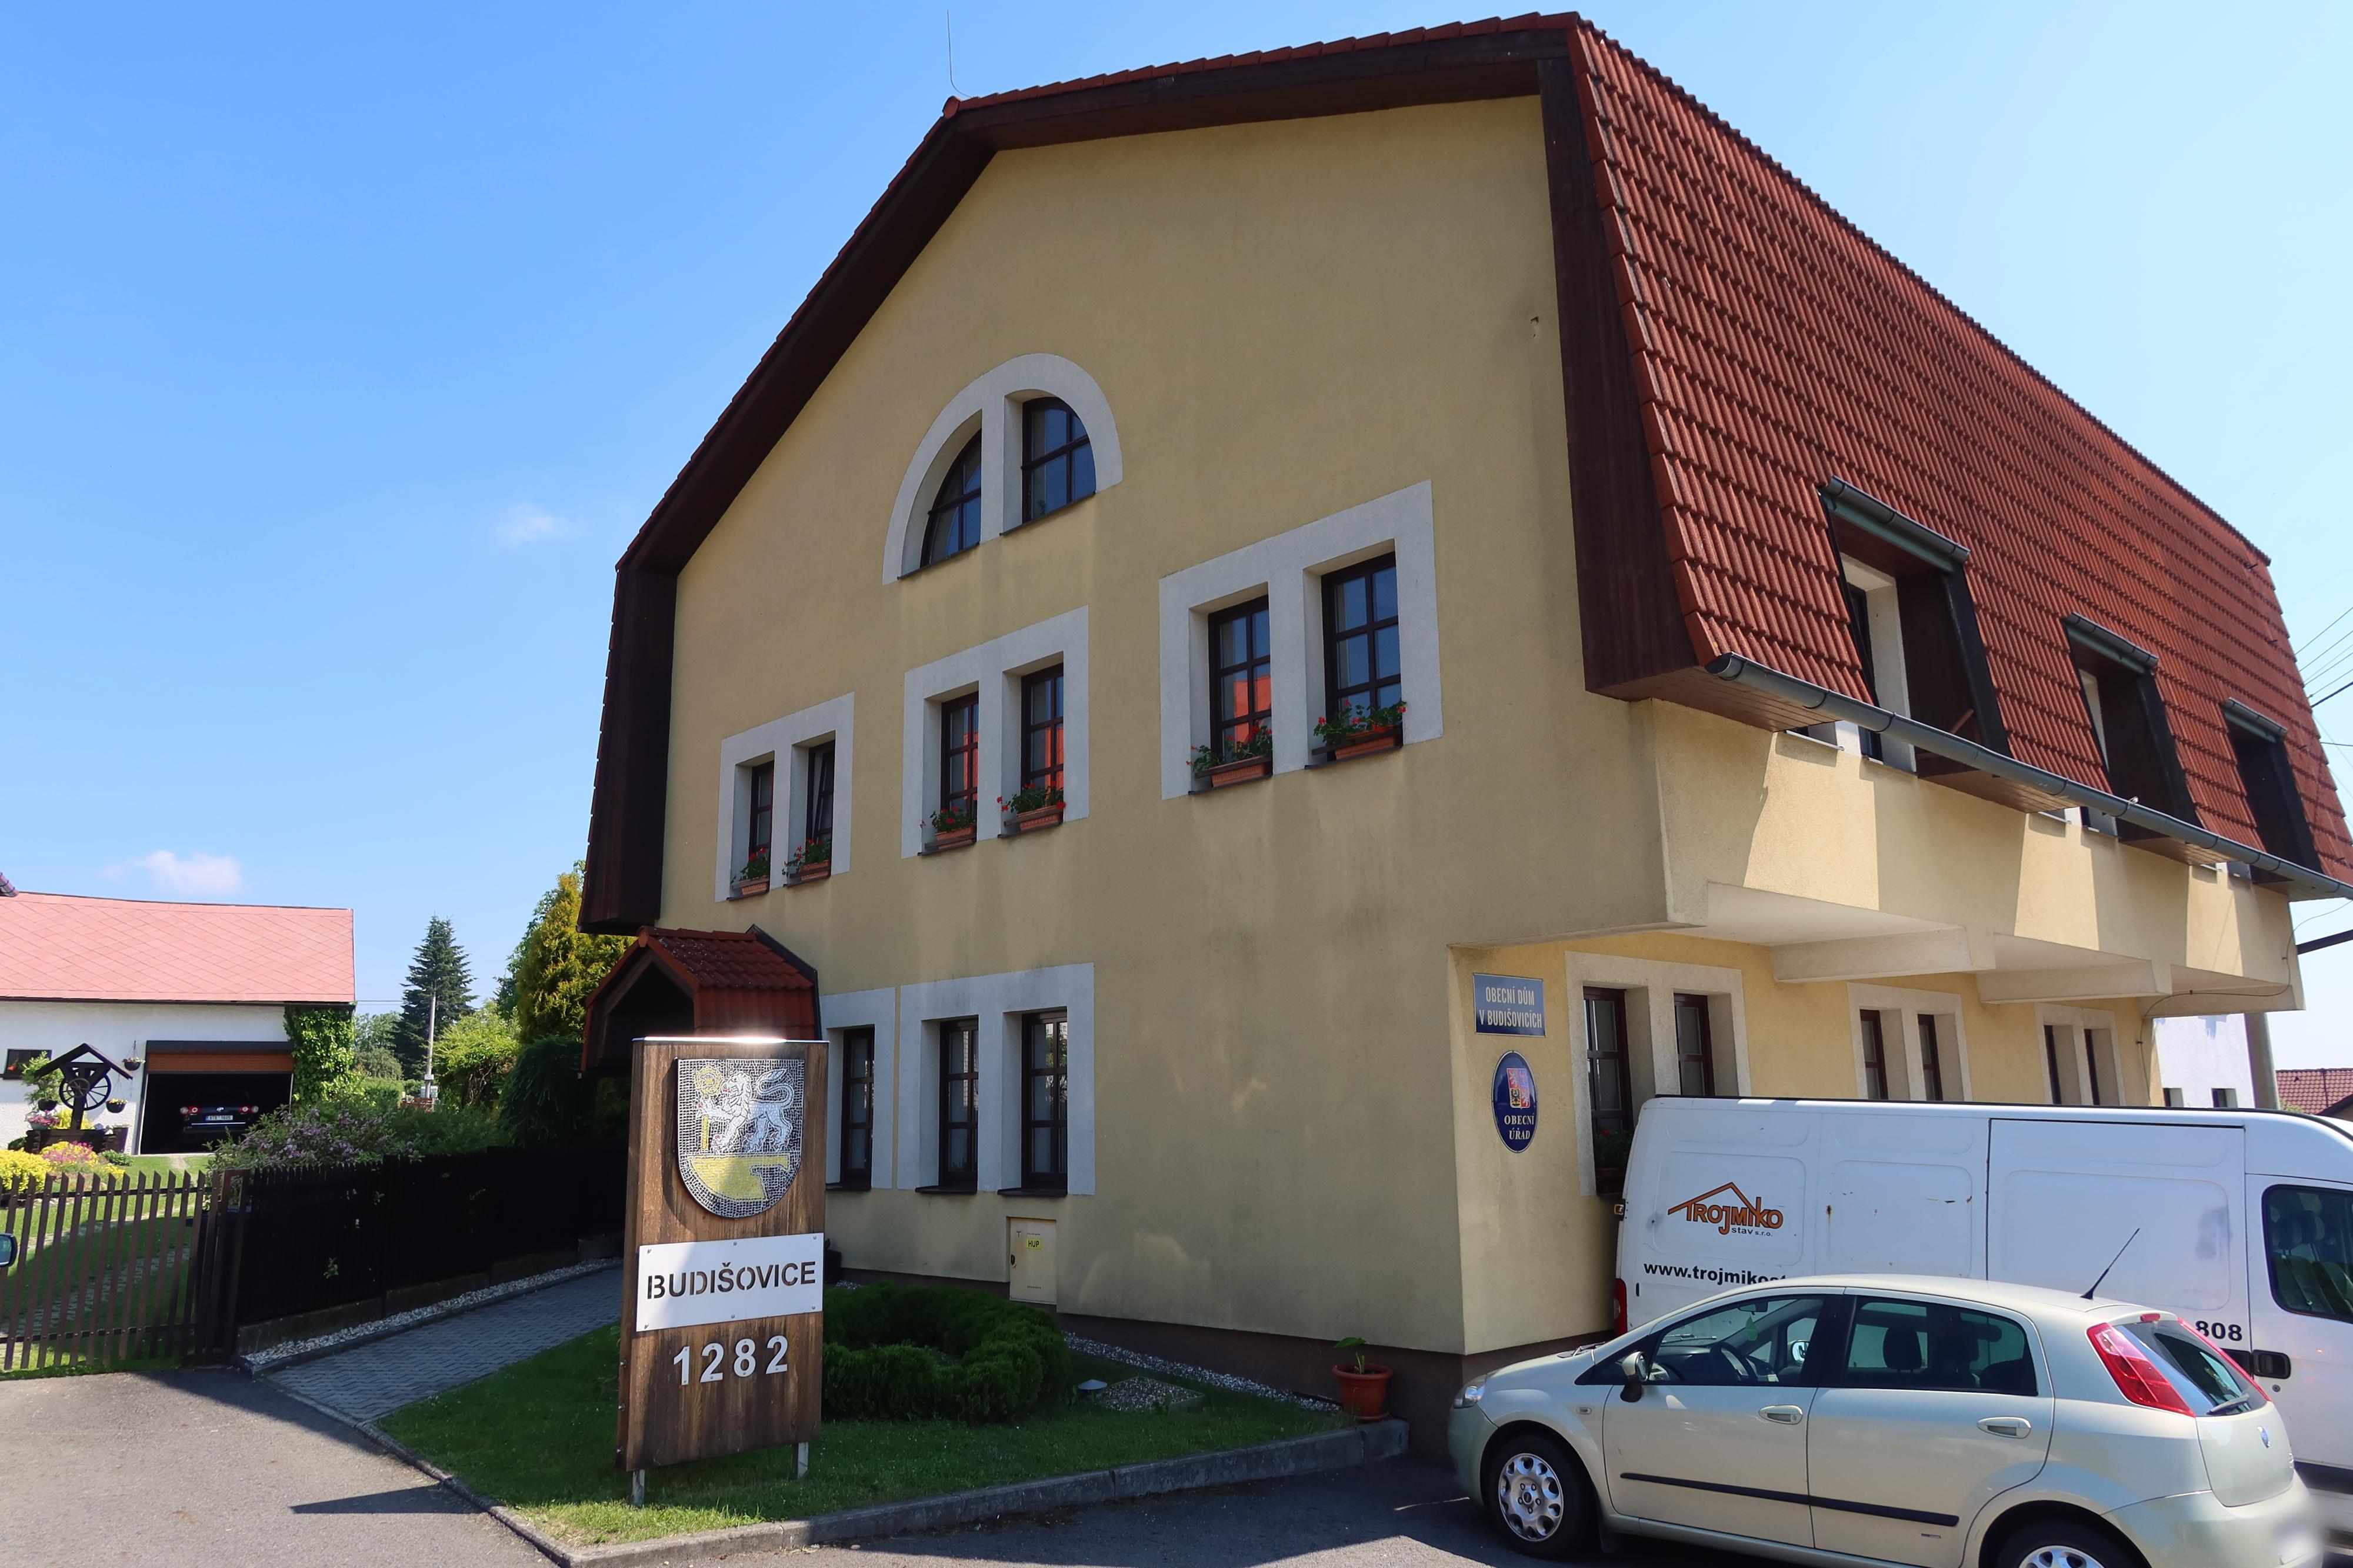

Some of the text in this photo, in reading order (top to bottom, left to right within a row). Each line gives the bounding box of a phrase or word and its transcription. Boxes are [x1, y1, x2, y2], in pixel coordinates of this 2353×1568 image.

[1485, 986, 1535, 1006] OBECNÍ DŮM
[1479, 1008, 1542, 1028] V BUDIŠOVICÍCH
[1504, 1112, 1534, 1125] OBECNÍ
[1509, 1127, 1531, 1140] ÚŘAD
[1668, 1196, 1784, 1235] TROJMIKO
[647, 1261, 816, 1299] BUDIŠOVICE
[673, 1335, 788, 1386] 1282
